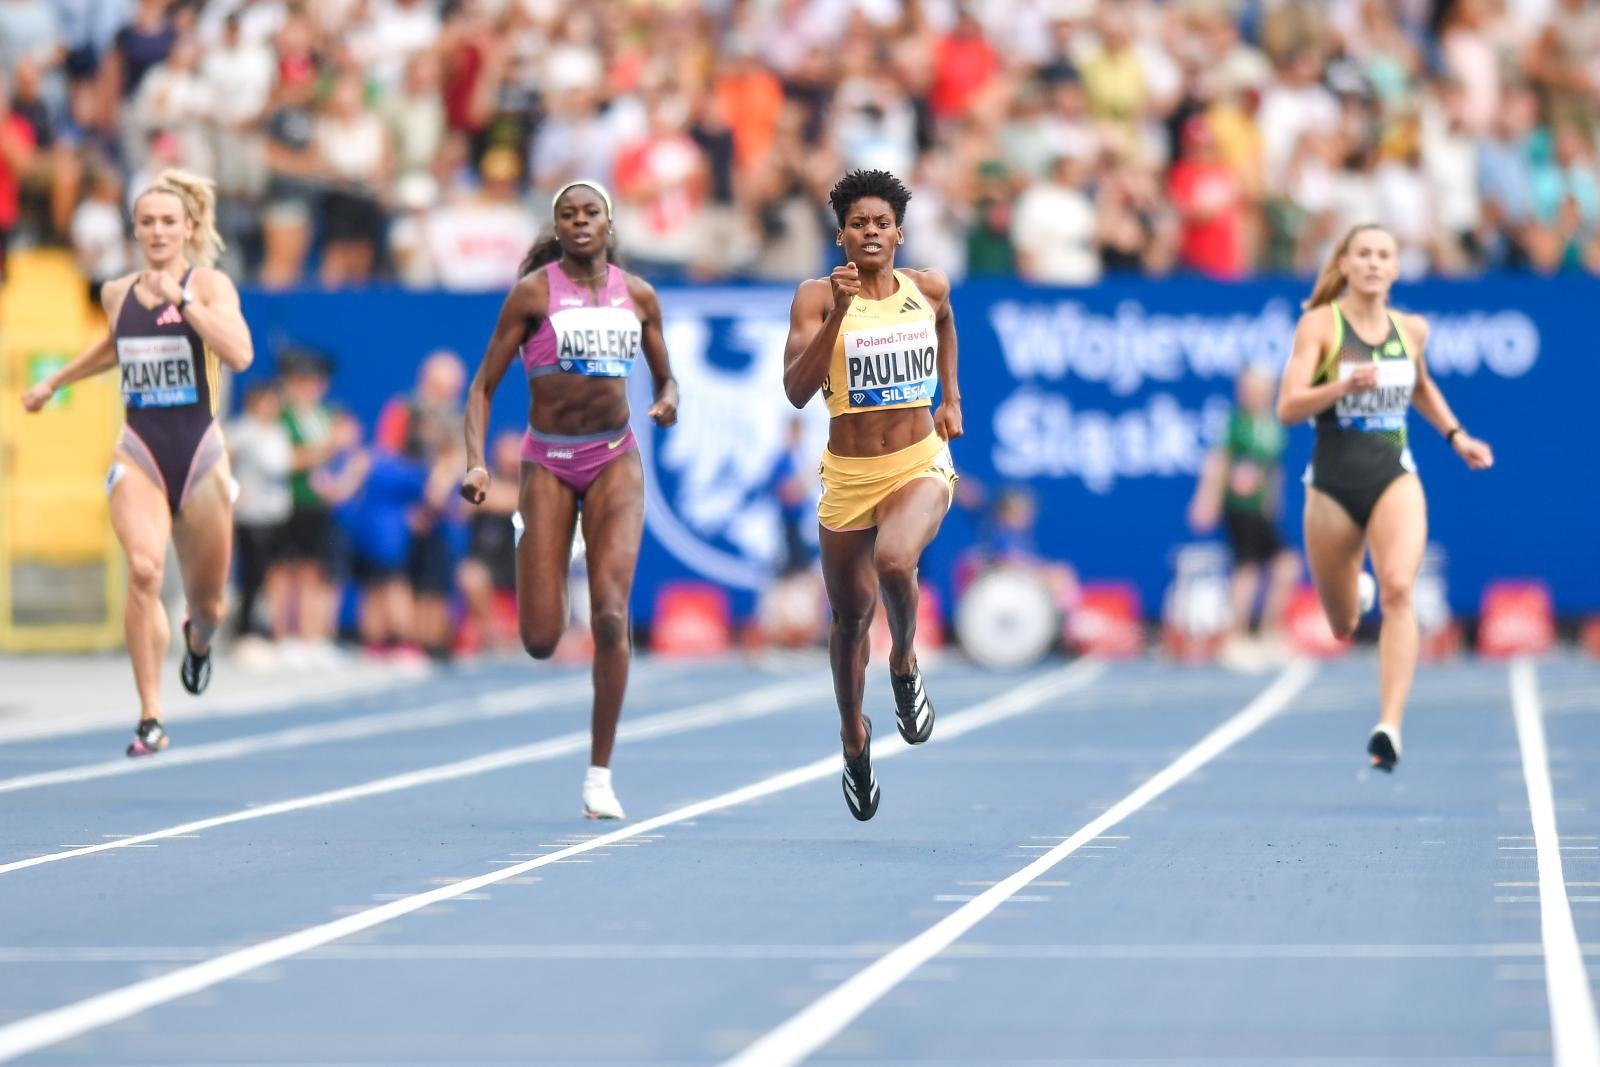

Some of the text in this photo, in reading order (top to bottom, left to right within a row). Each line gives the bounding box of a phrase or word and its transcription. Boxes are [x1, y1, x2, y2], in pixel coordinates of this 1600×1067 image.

[561, 330, 639, 359] ADELEKE
[856, 328, 928, 348] Poland.Travel
[991, 300, 1539, 394] Wojewówo
[121, 359, 192, 392] KLAVER
[848, 346, 935, 388] PAULINO
[881, 384, 928, 402] SILESIA
